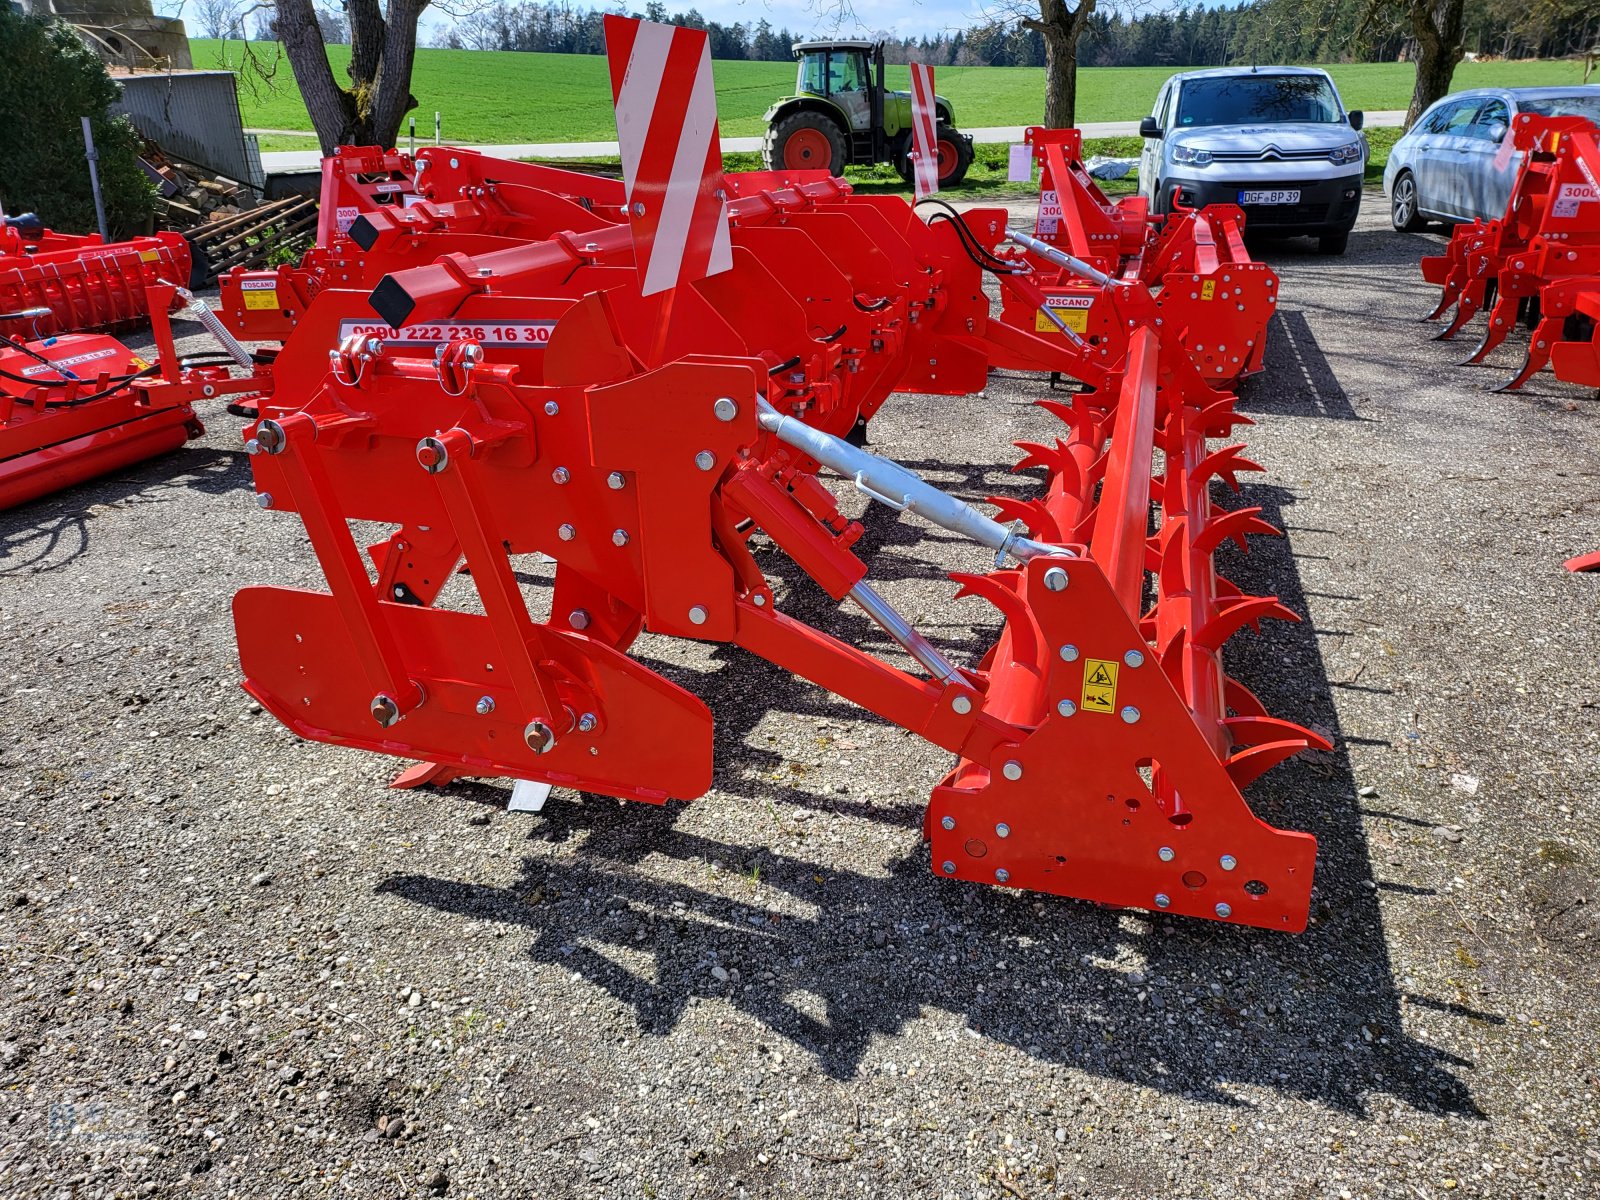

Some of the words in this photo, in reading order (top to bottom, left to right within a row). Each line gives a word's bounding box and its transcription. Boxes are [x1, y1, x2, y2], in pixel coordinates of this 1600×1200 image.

[1244, 192, 1265, 203] DGF
[1270, 192, 1285, 202] BP
[1286, 191, 1299, 202] 39
[338, 209, 357, 218] 3000
[1046, 298, 1090, 307] OSCANO
[406, 326, 443, 341] 222
[448, 327, 486, 341] 236
[492, 327, 518, 341] 16
[524, 327, 550, 342] 30
